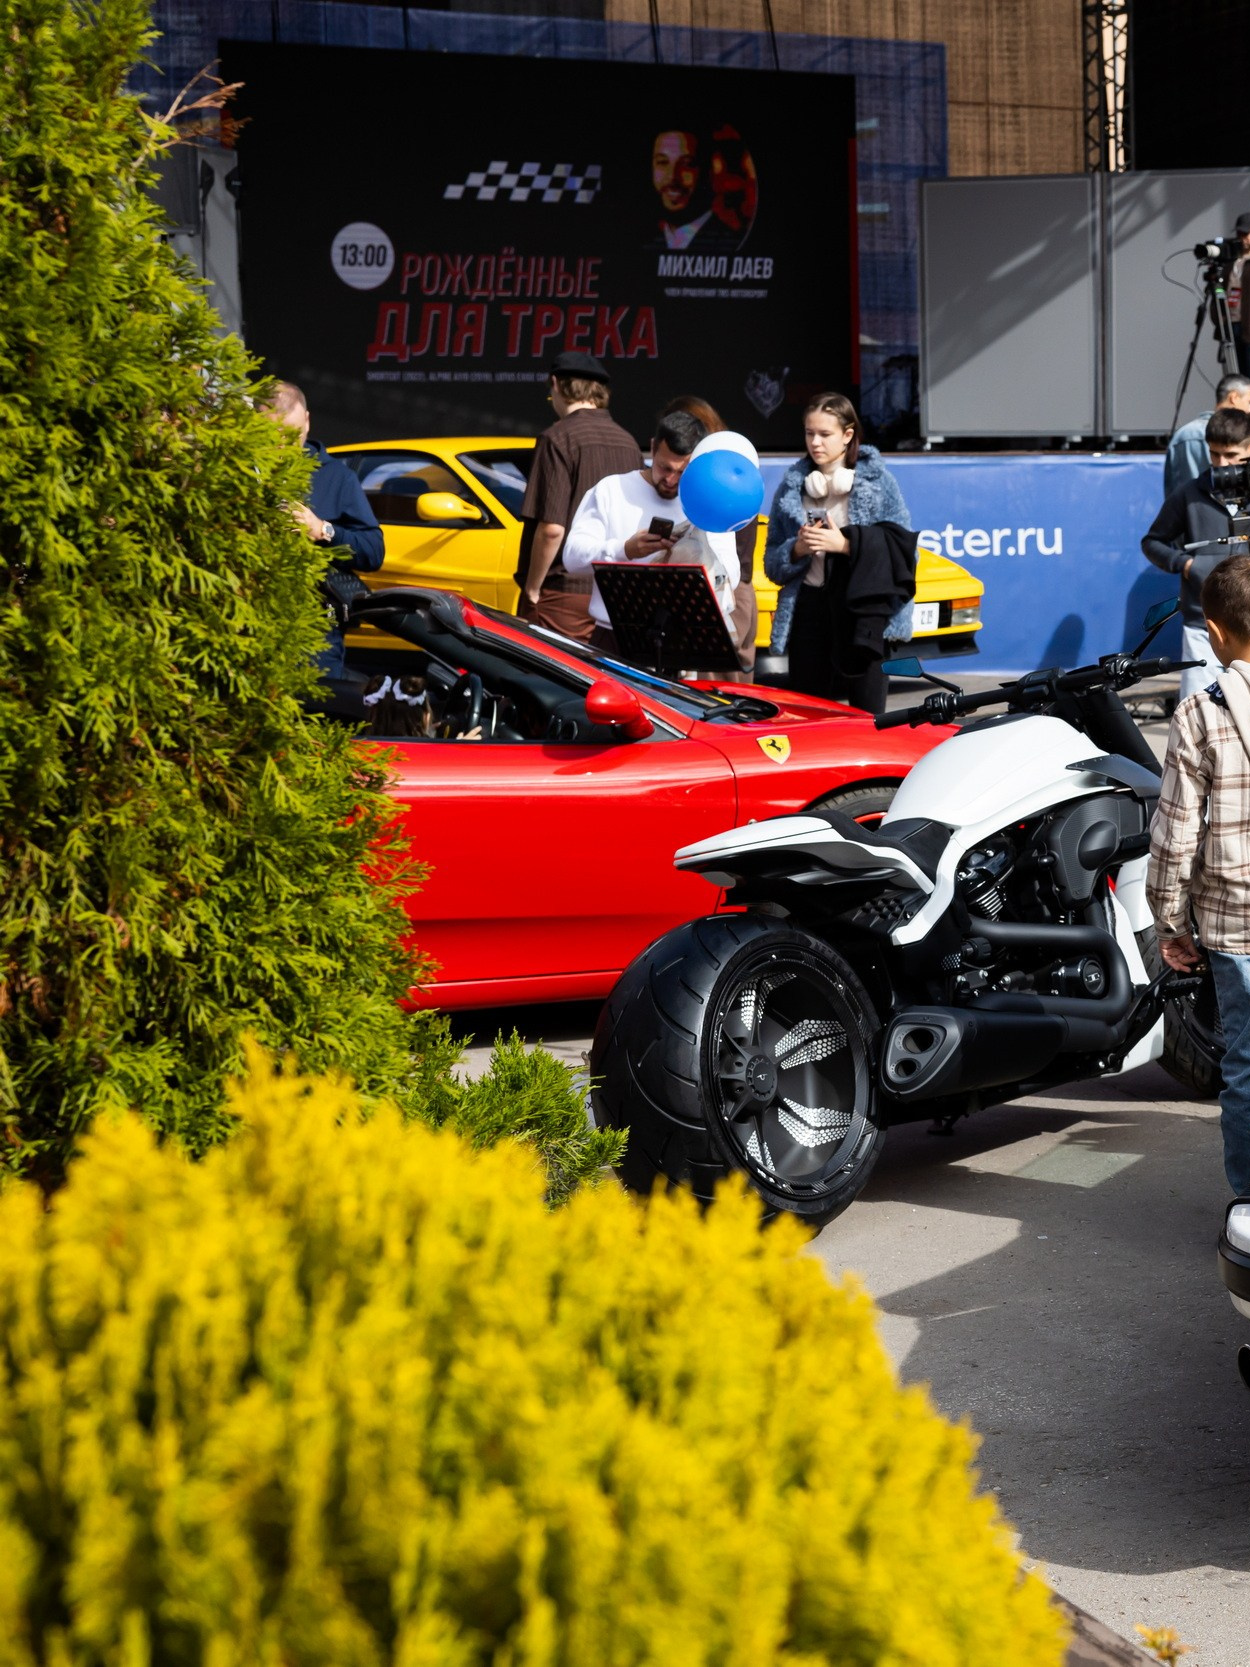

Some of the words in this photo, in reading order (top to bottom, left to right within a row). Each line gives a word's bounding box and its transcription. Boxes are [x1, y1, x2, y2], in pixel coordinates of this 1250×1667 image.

[339, 243, 387, 267] 13:00
[400, 246, 602, 301] РОЖДЁННЫЕ
[657, 255, 728, 278] МИХАИЛ
[729, 256, 774, 281] ДАЕВ
[366, 302, 488, 364] ДЛЯ
[502, 304, 659, 359] ТРЕКА
